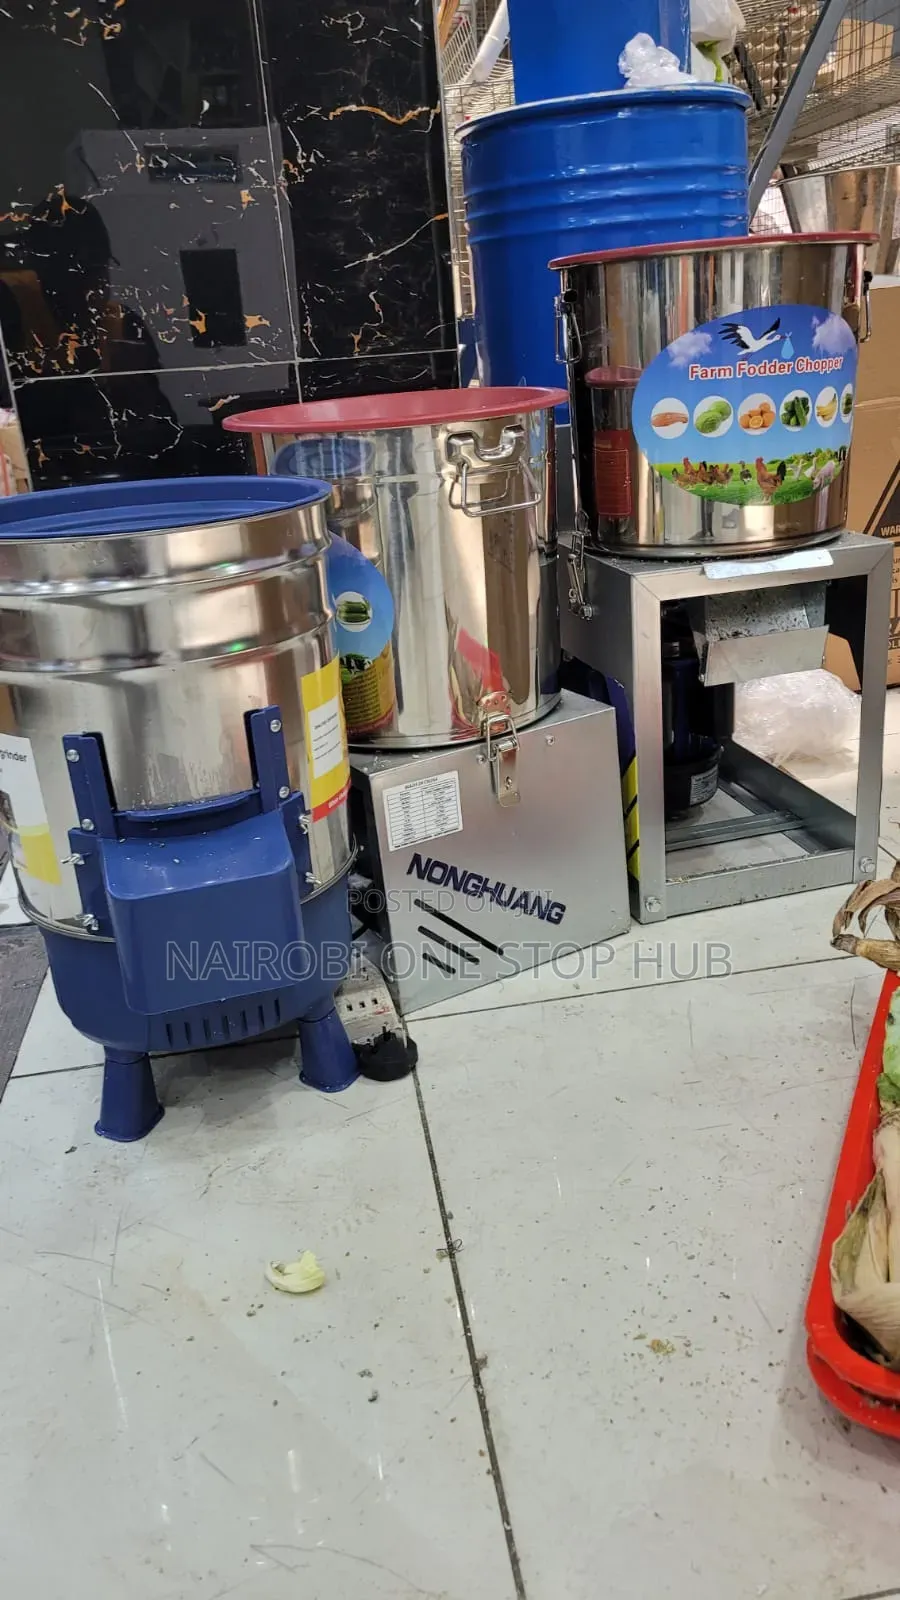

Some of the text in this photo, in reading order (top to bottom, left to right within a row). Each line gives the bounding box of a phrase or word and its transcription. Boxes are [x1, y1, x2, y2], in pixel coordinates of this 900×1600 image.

[689, 356, 843, 380] Farm Fodder Chopper
[406, 853, 567, 925] NONGHUANG
